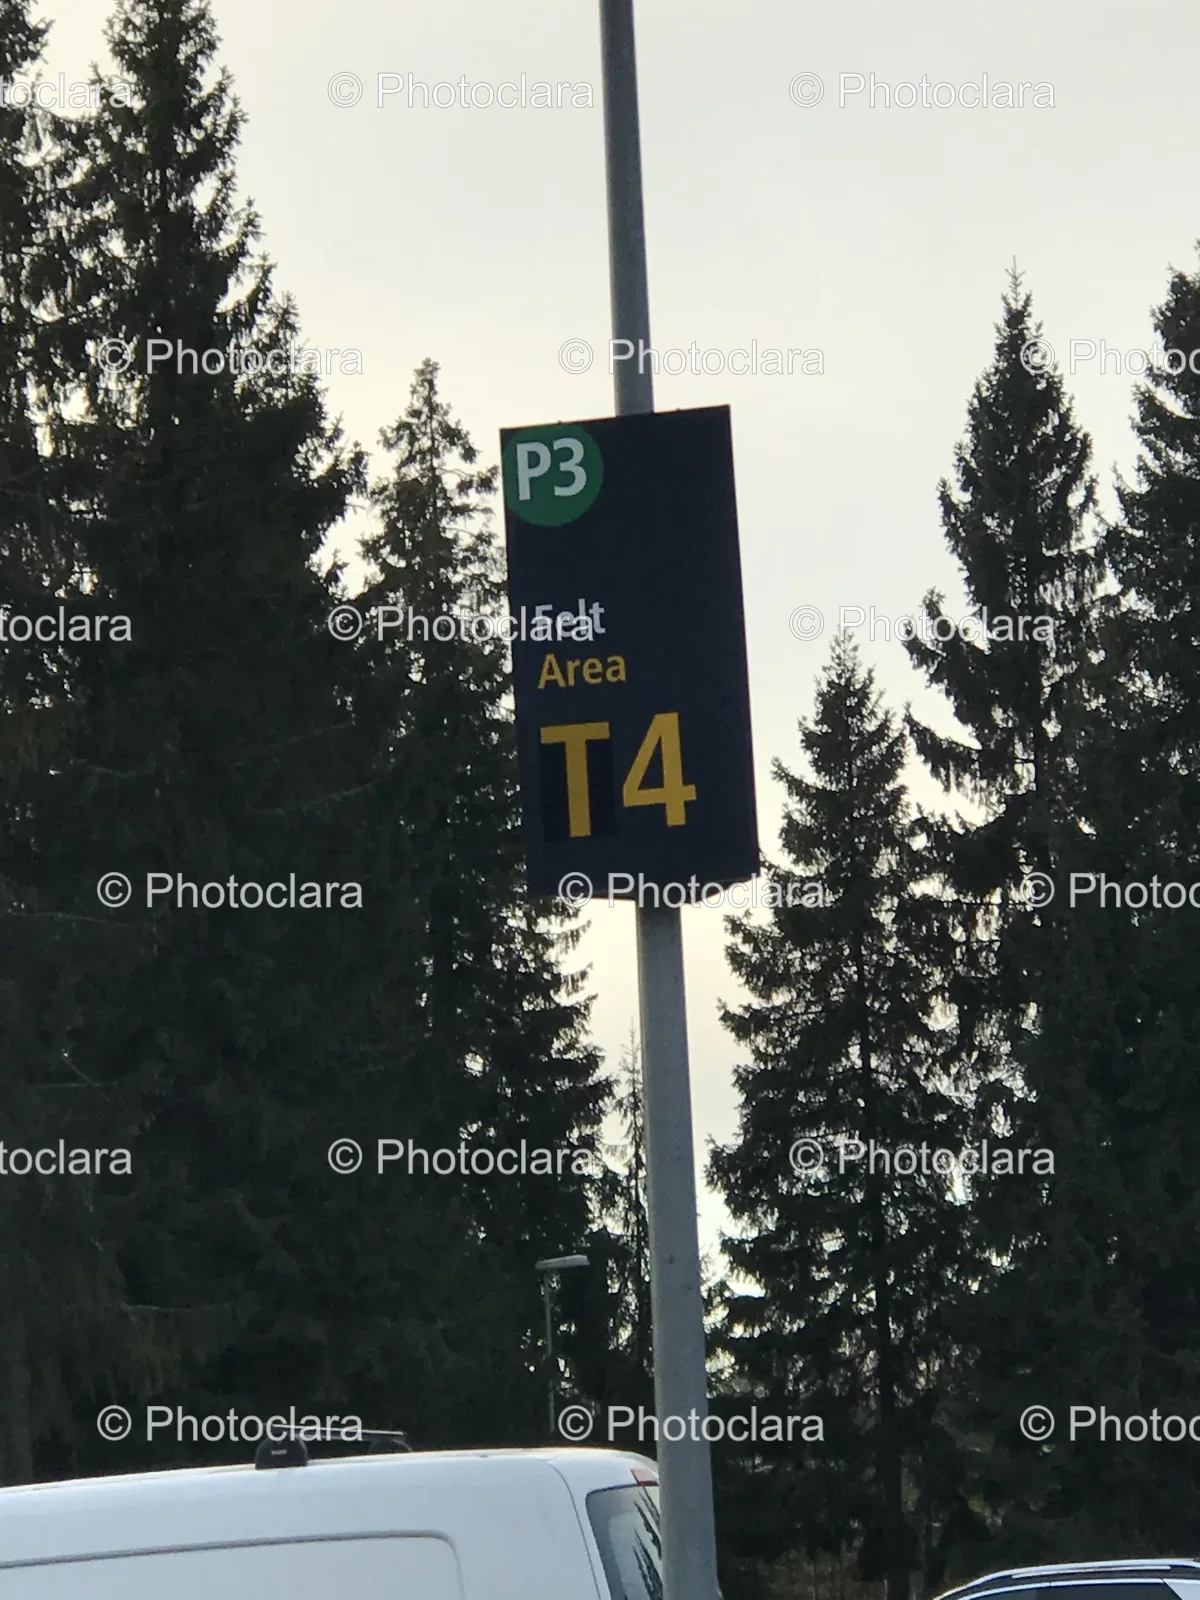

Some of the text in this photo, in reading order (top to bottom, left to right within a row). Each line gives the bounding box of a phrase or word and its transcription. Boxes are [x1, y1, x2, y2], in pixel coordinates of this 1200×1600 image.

[516, 437, 587, 501] P3
[534, 598, 606, 638] Felt
[537, 653, 627, 689] Area
[540, 712, 697, 838] T4
